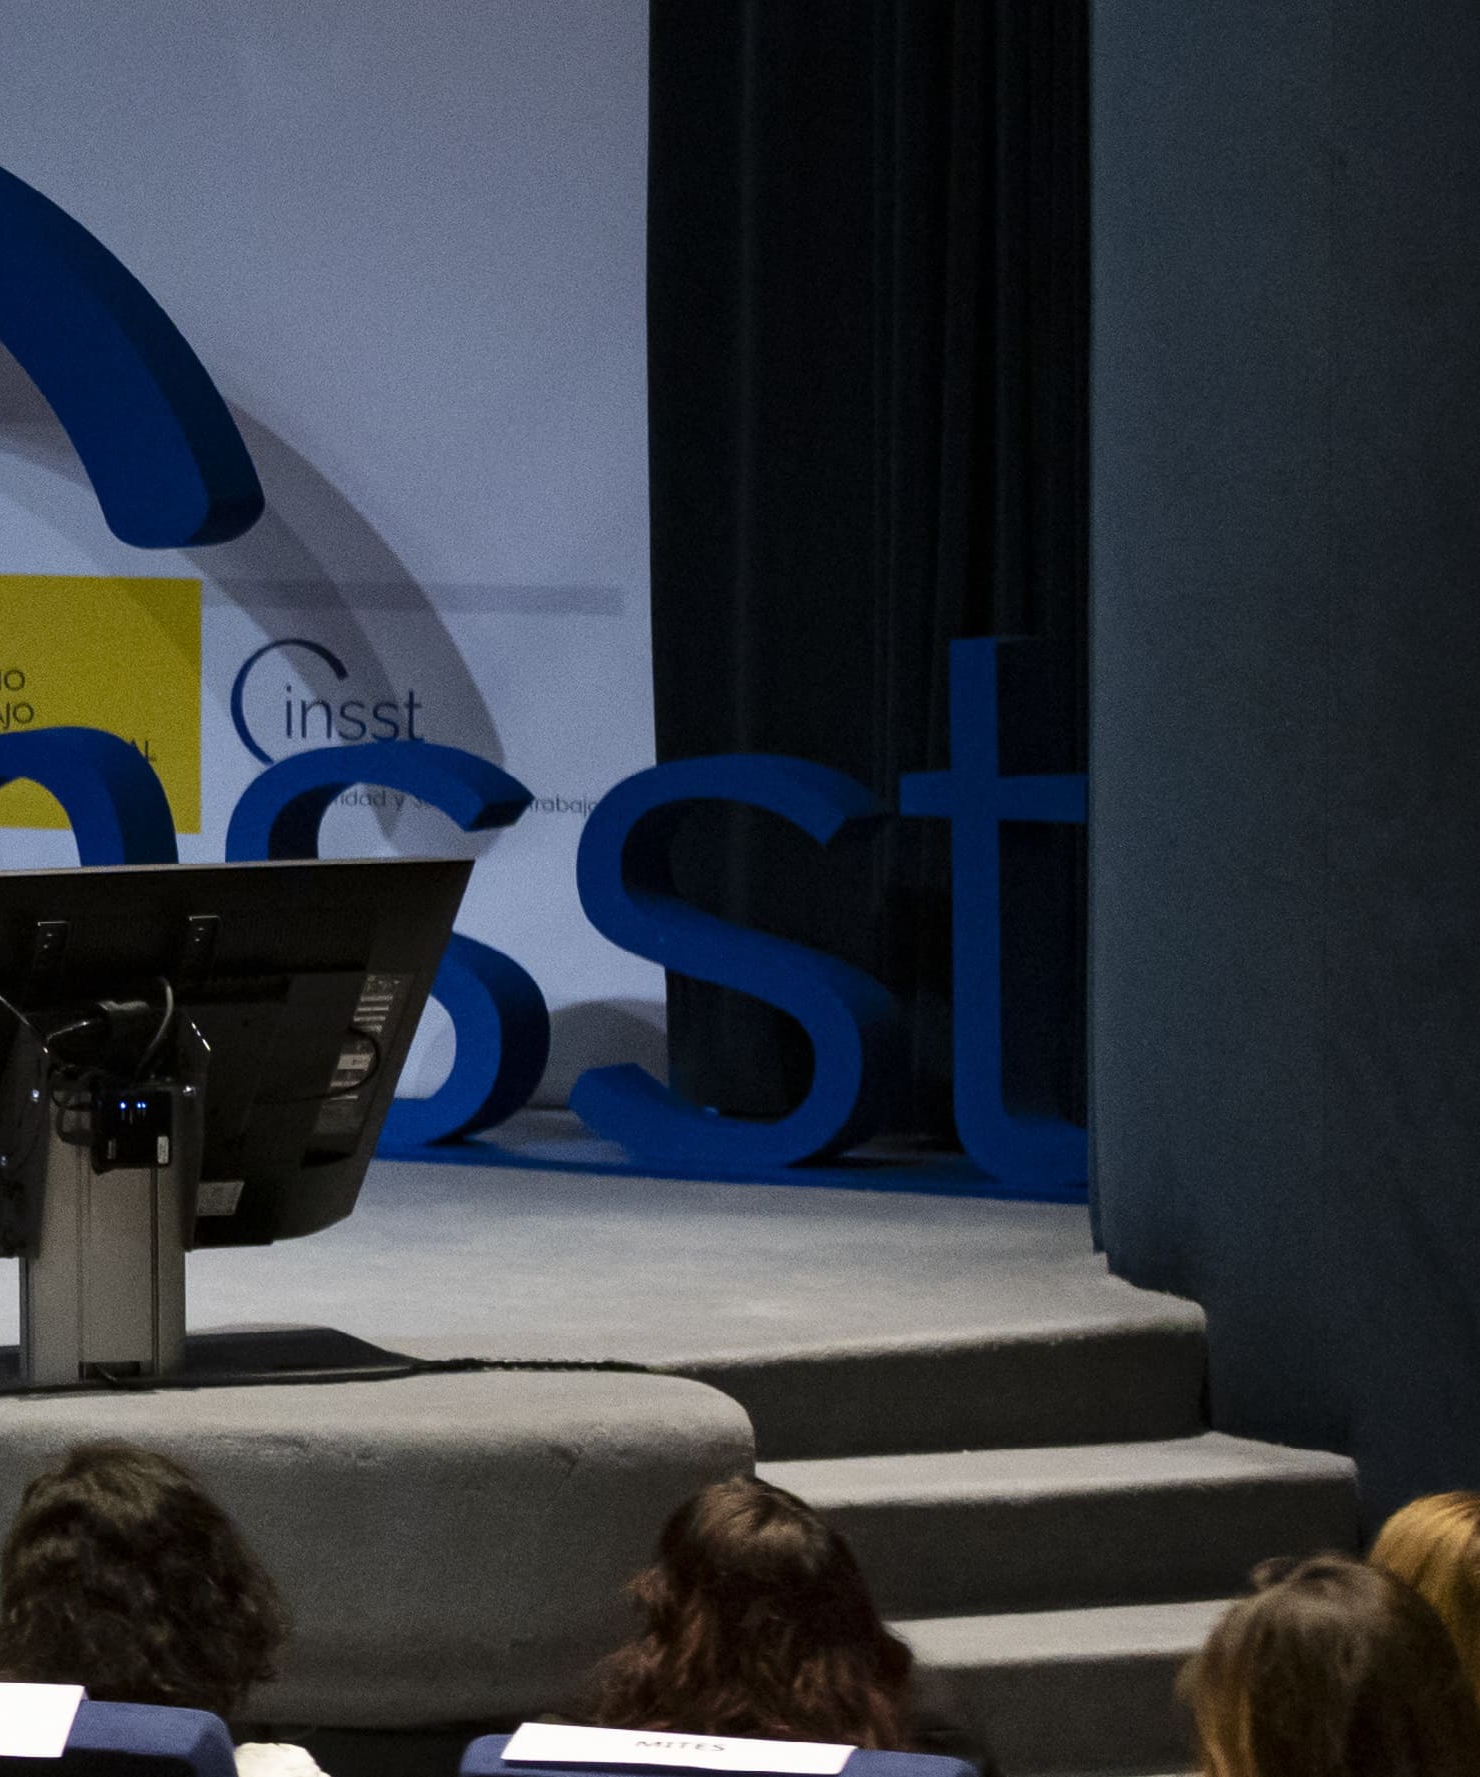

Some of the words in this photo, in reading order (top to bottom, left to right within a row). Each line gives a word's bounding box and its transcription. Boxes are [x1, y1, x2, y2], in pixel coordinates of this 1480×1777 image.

[285, 684, 425, 740] insst
[528, 794, 598, 817] rabaj
[634, 1740, 726, 1752] MITES
